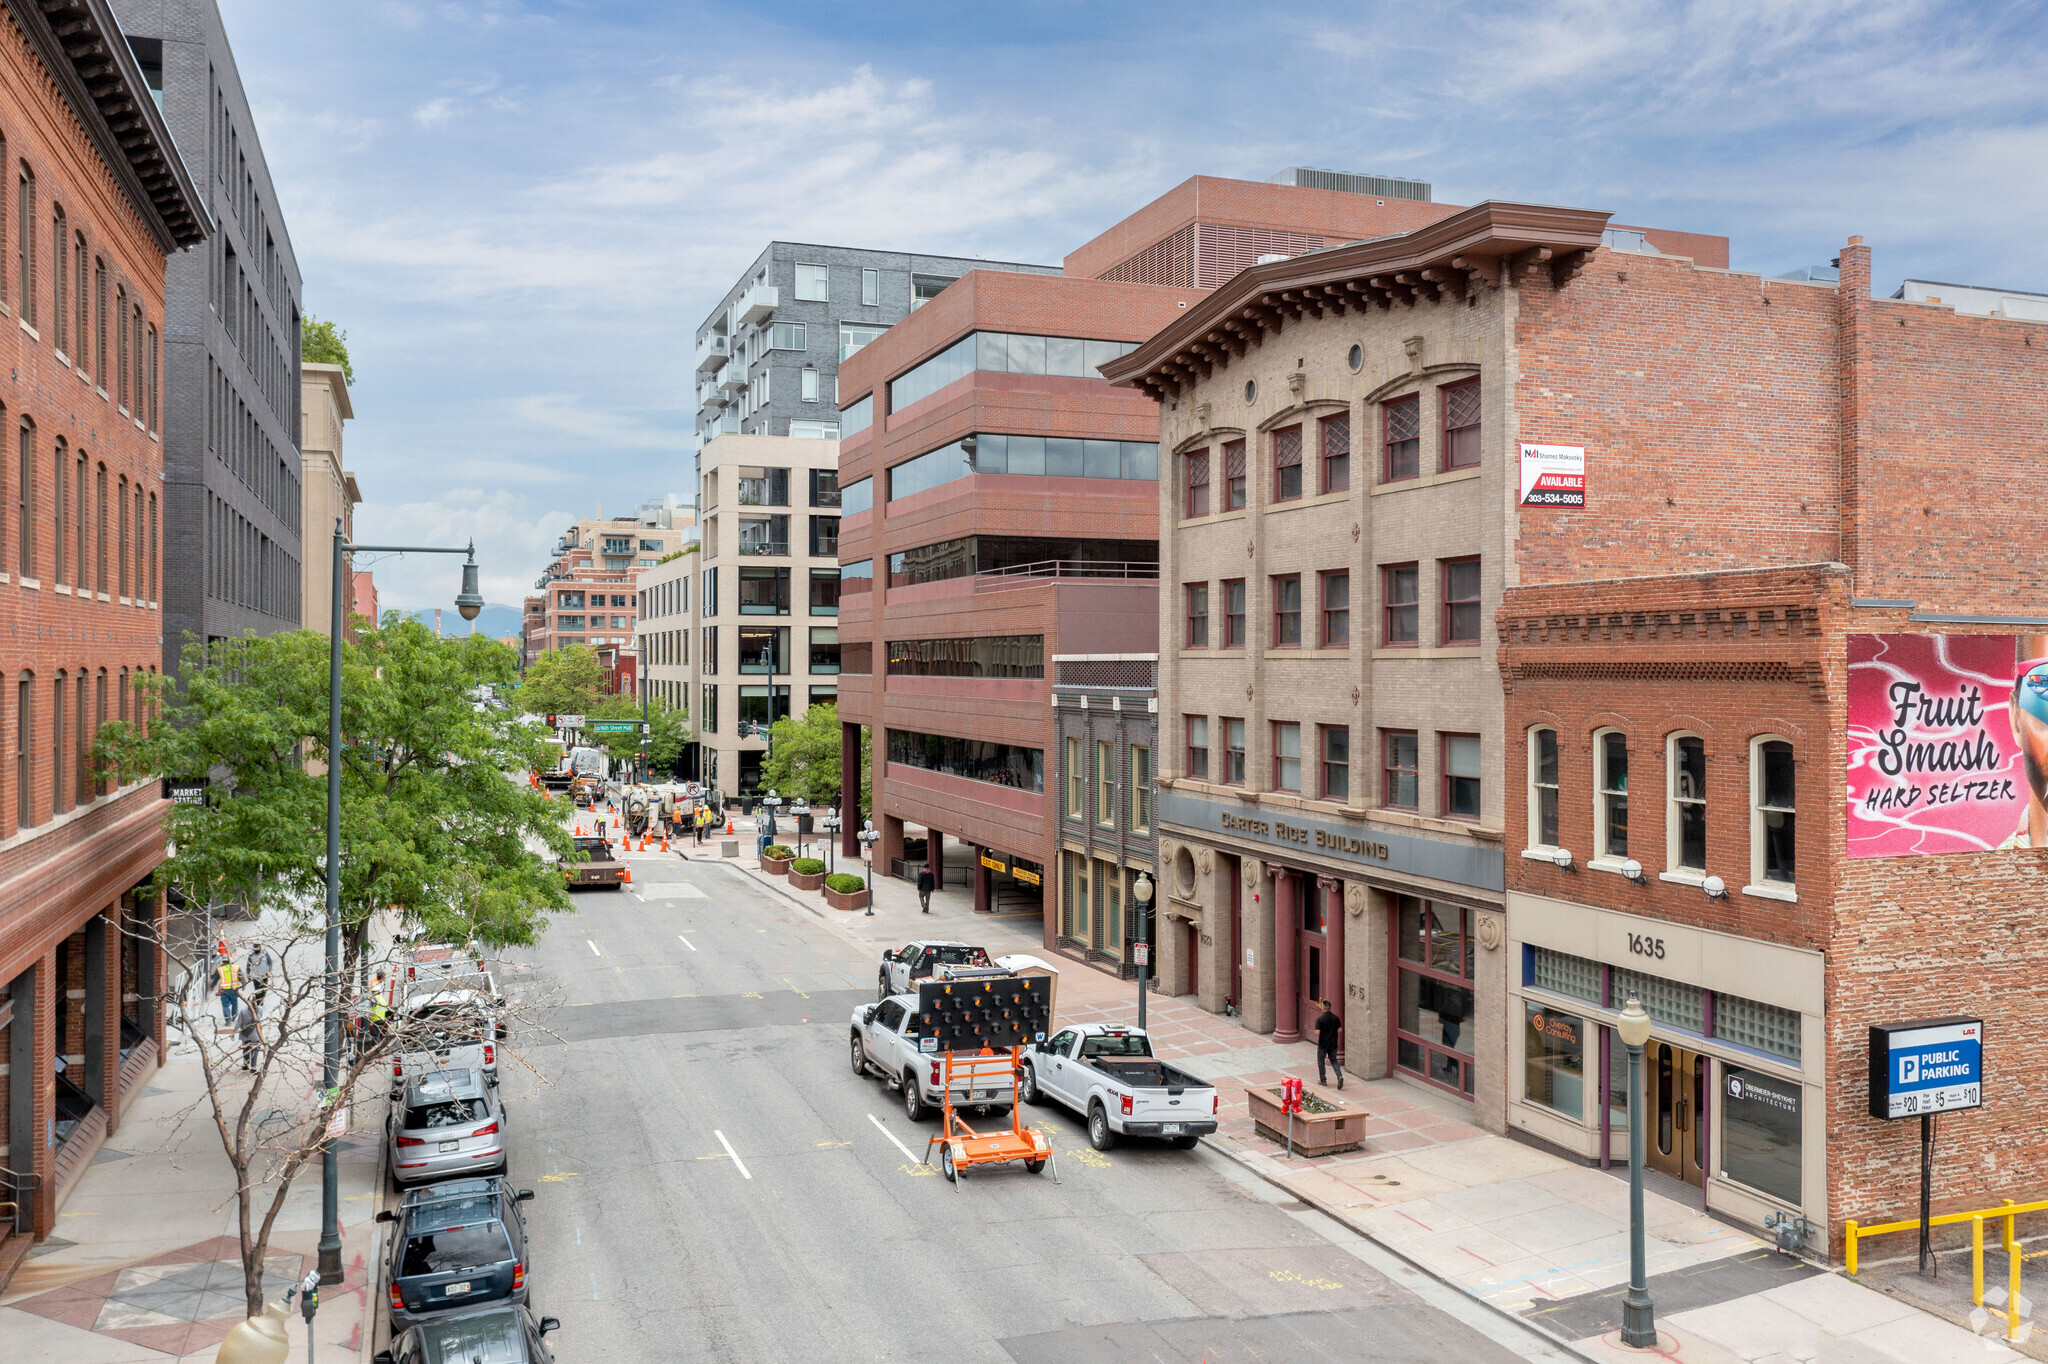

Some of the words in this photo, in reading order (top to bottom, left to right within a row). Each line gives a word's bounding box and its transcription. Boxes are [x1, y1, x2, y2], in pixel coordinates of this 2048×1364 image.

[1524, 449, 1539, 459] NAI
[1539, 452, 1558, 460] Shames
[1540, 476, 1583, 488] AVAILABLE
[1528, 493, 1583, 504] 303-534-5005
[1889, 681, 1984, 728] Fruit
[1877, 728, 2000, 776] Smash
[173, 788, 202, 797] MARKET
[1866, 784, 1922, 811] HARD
[1926, 779, 2016, 805] SELTZER
[1221, 811, 1269, 836] CARTER
[1275, 821, 1308, 843] RICE
[1315, 828, 1388, 859] BUILDING
[1628, 932, 1665, 960] 1635
[1545, 1025, 1576, 1044] Consulting
[1549, 1018, 1573, 1034] Overlay
[1962, 1028, 1976, 1036] LAZ
[1921, 1049, 1960, 1066] PUBLIC
[1921, 1063, 1970, 1081] PARKING
[1745, 1091, 1796, 1112] ARCHITECTURE
[1903, 1095, 1918, 1112] $20
[1935, 1091, 1945, 1107] $5
[1963, 1087, 1977, 1104] $10
